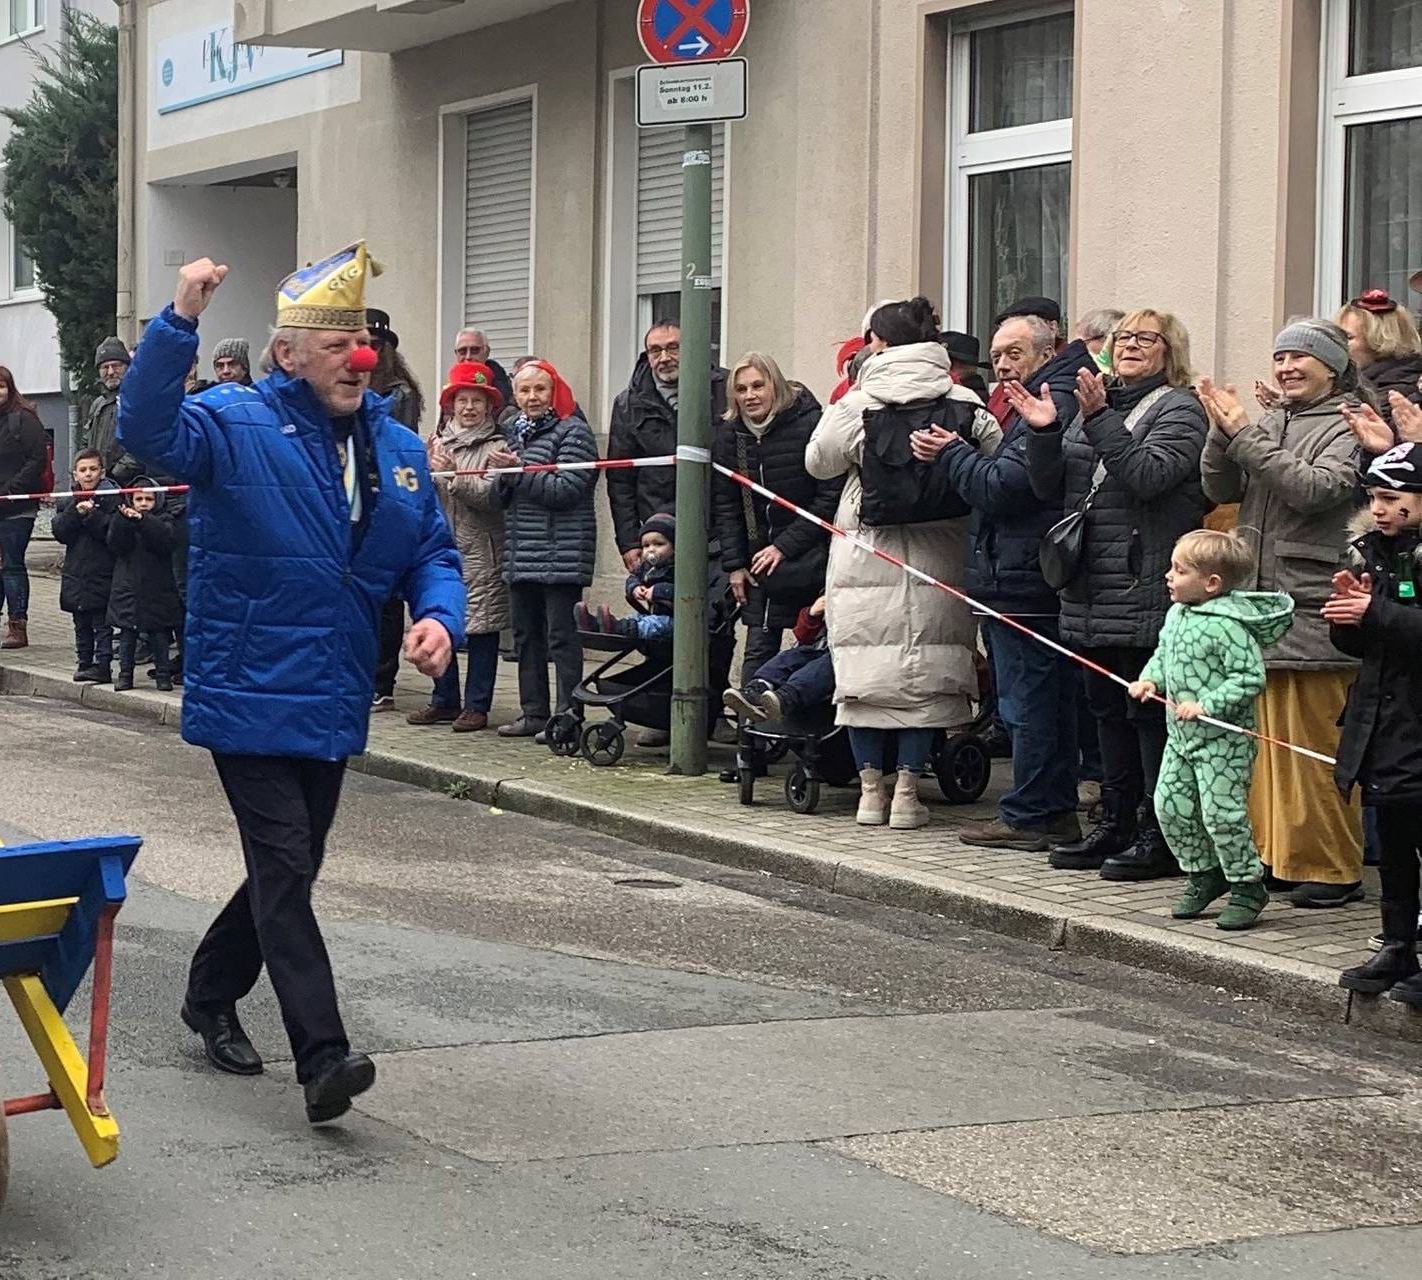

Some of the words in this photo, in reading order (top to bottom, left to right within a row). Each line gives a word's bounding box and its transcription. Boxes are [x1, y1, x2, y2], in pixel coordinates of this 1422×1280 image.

[659, 86, 691, 94] Sonntag
[667, 97, 678, 105] ab
[701, 94, 708, 102] h
[327, 265, 358, 291] GKG
